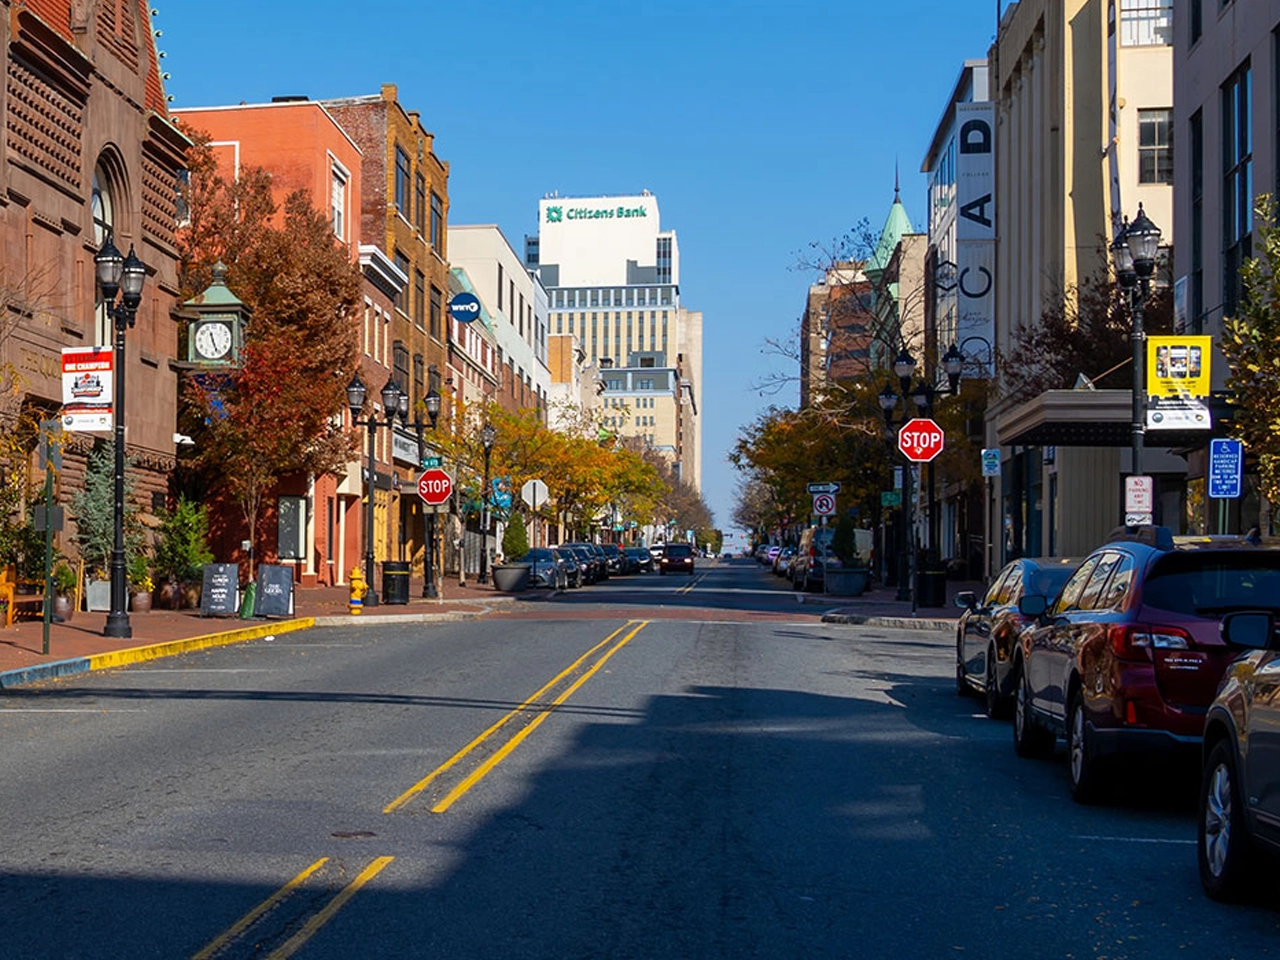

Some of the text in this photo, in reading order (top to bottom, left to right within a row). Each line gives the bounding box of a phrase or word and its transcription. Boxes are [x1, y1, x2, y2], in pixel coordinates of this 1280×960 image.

[566, 205, 647, 220] Citizens Bank
[65, 361, 110, 371] ONE CHAMPION
[902, 431, 941, 448] STOP
[420, 480, 449, 494] STOP
